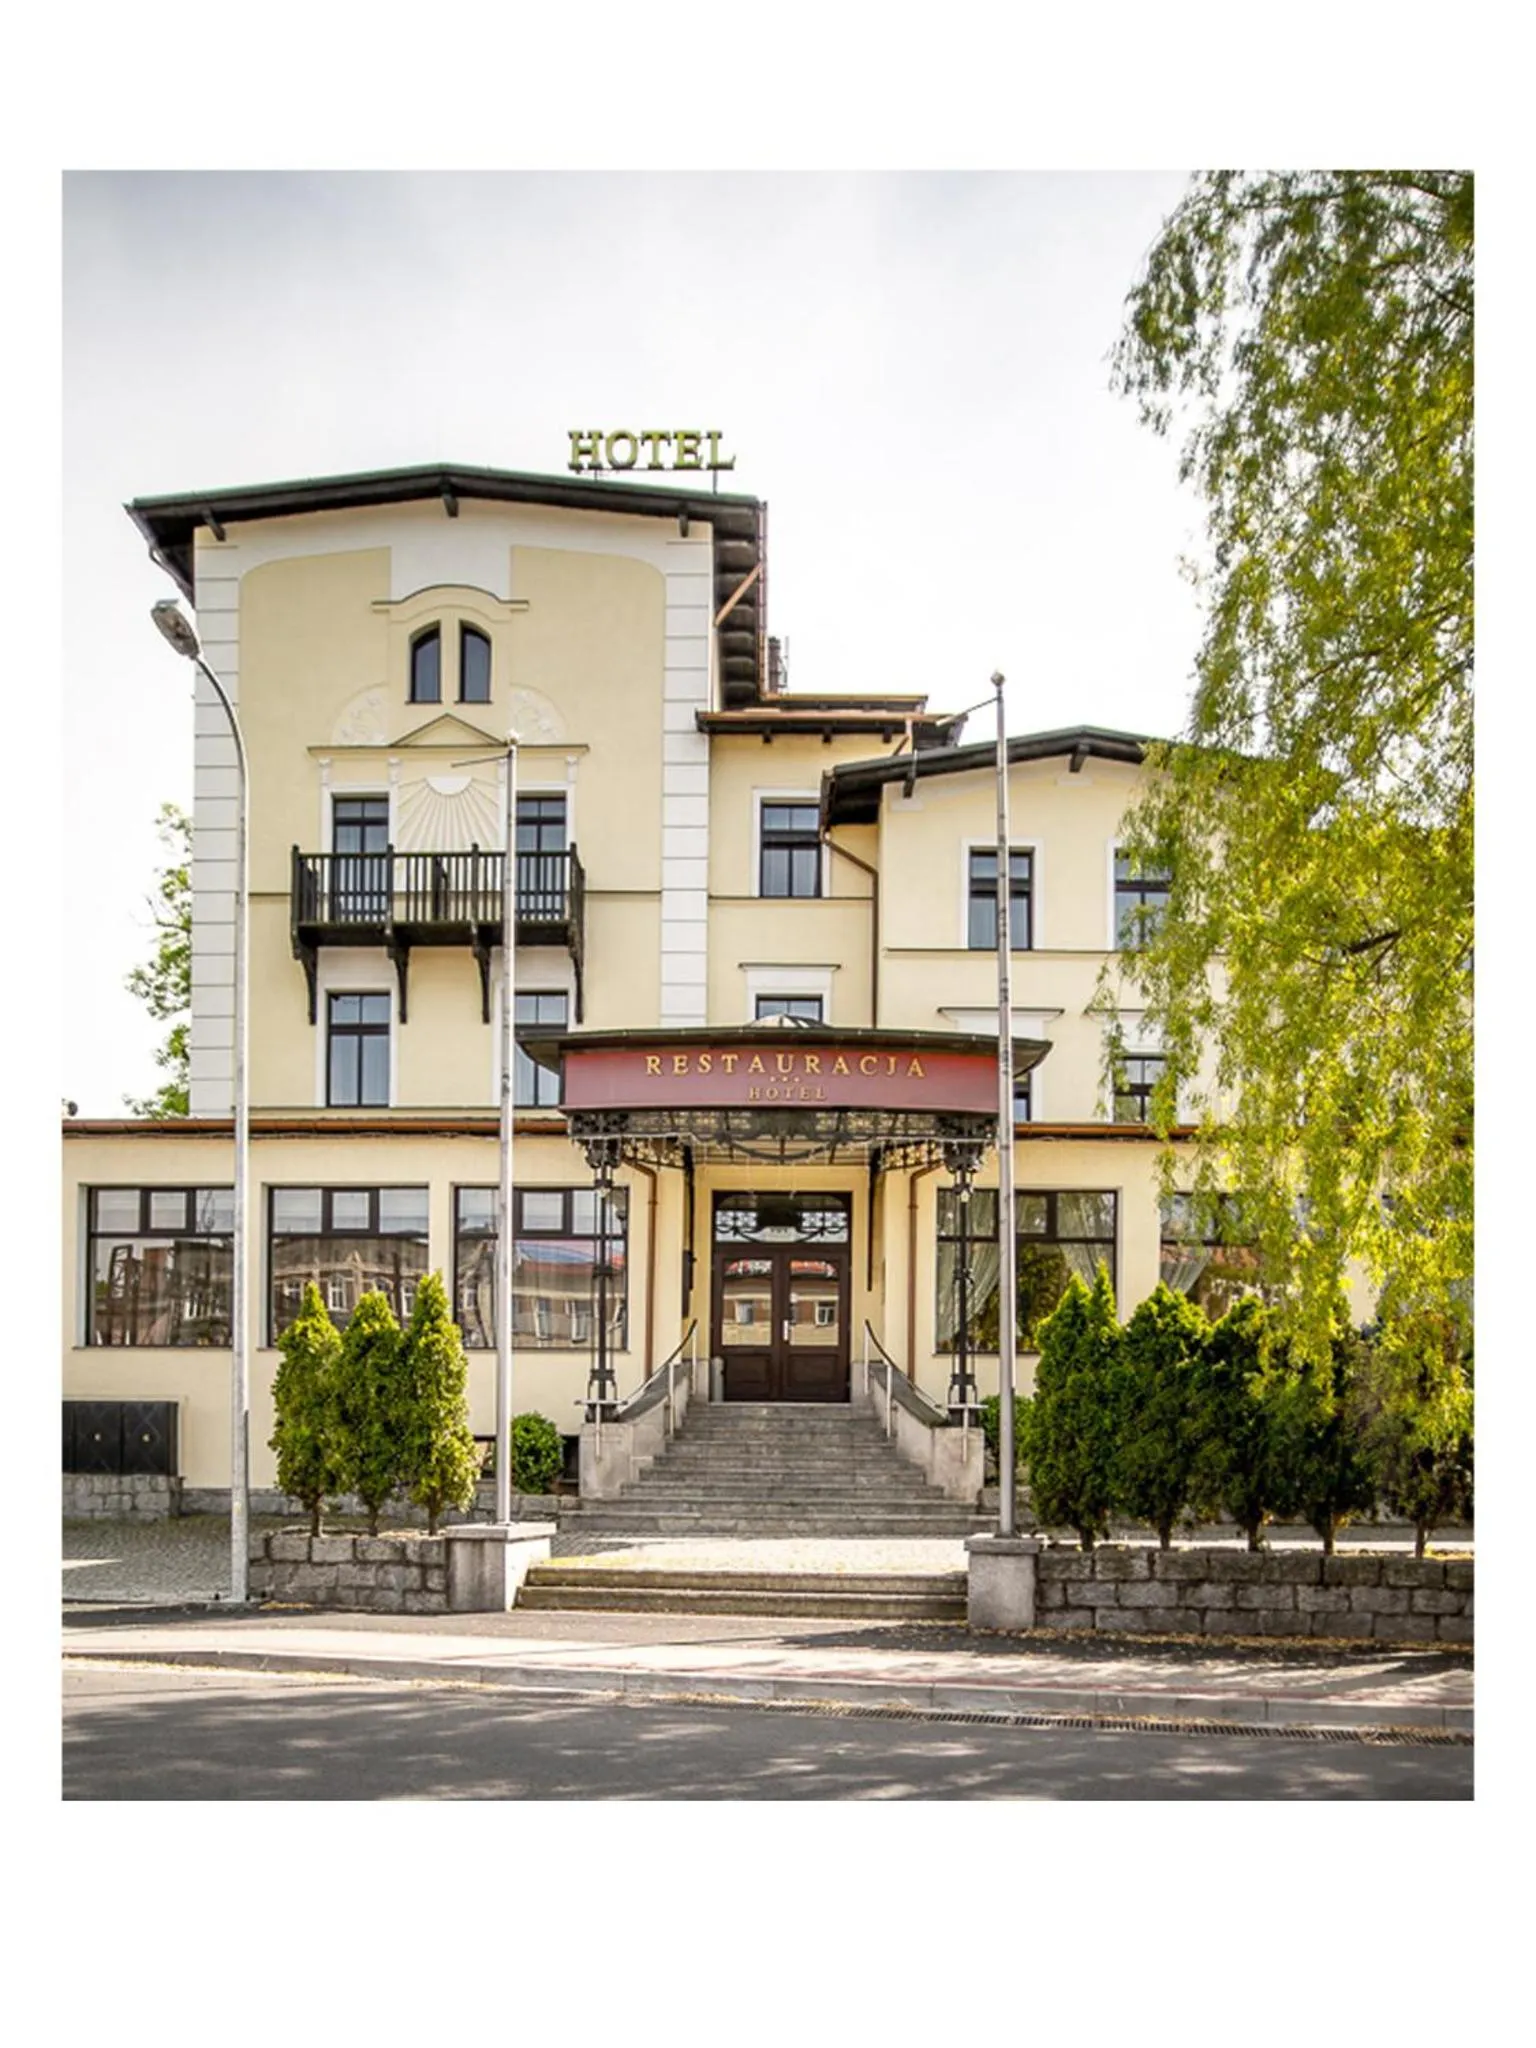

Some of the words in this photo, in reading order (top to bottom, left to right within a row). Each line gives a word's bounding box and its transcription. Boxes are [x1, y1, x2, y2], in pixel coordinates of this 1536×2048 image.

[568, 430, 736, 470] HOTEL
[645, 1054, 925, 1077] RESTAURACJA
[749, 1087, 827, 1100] HOTEL
